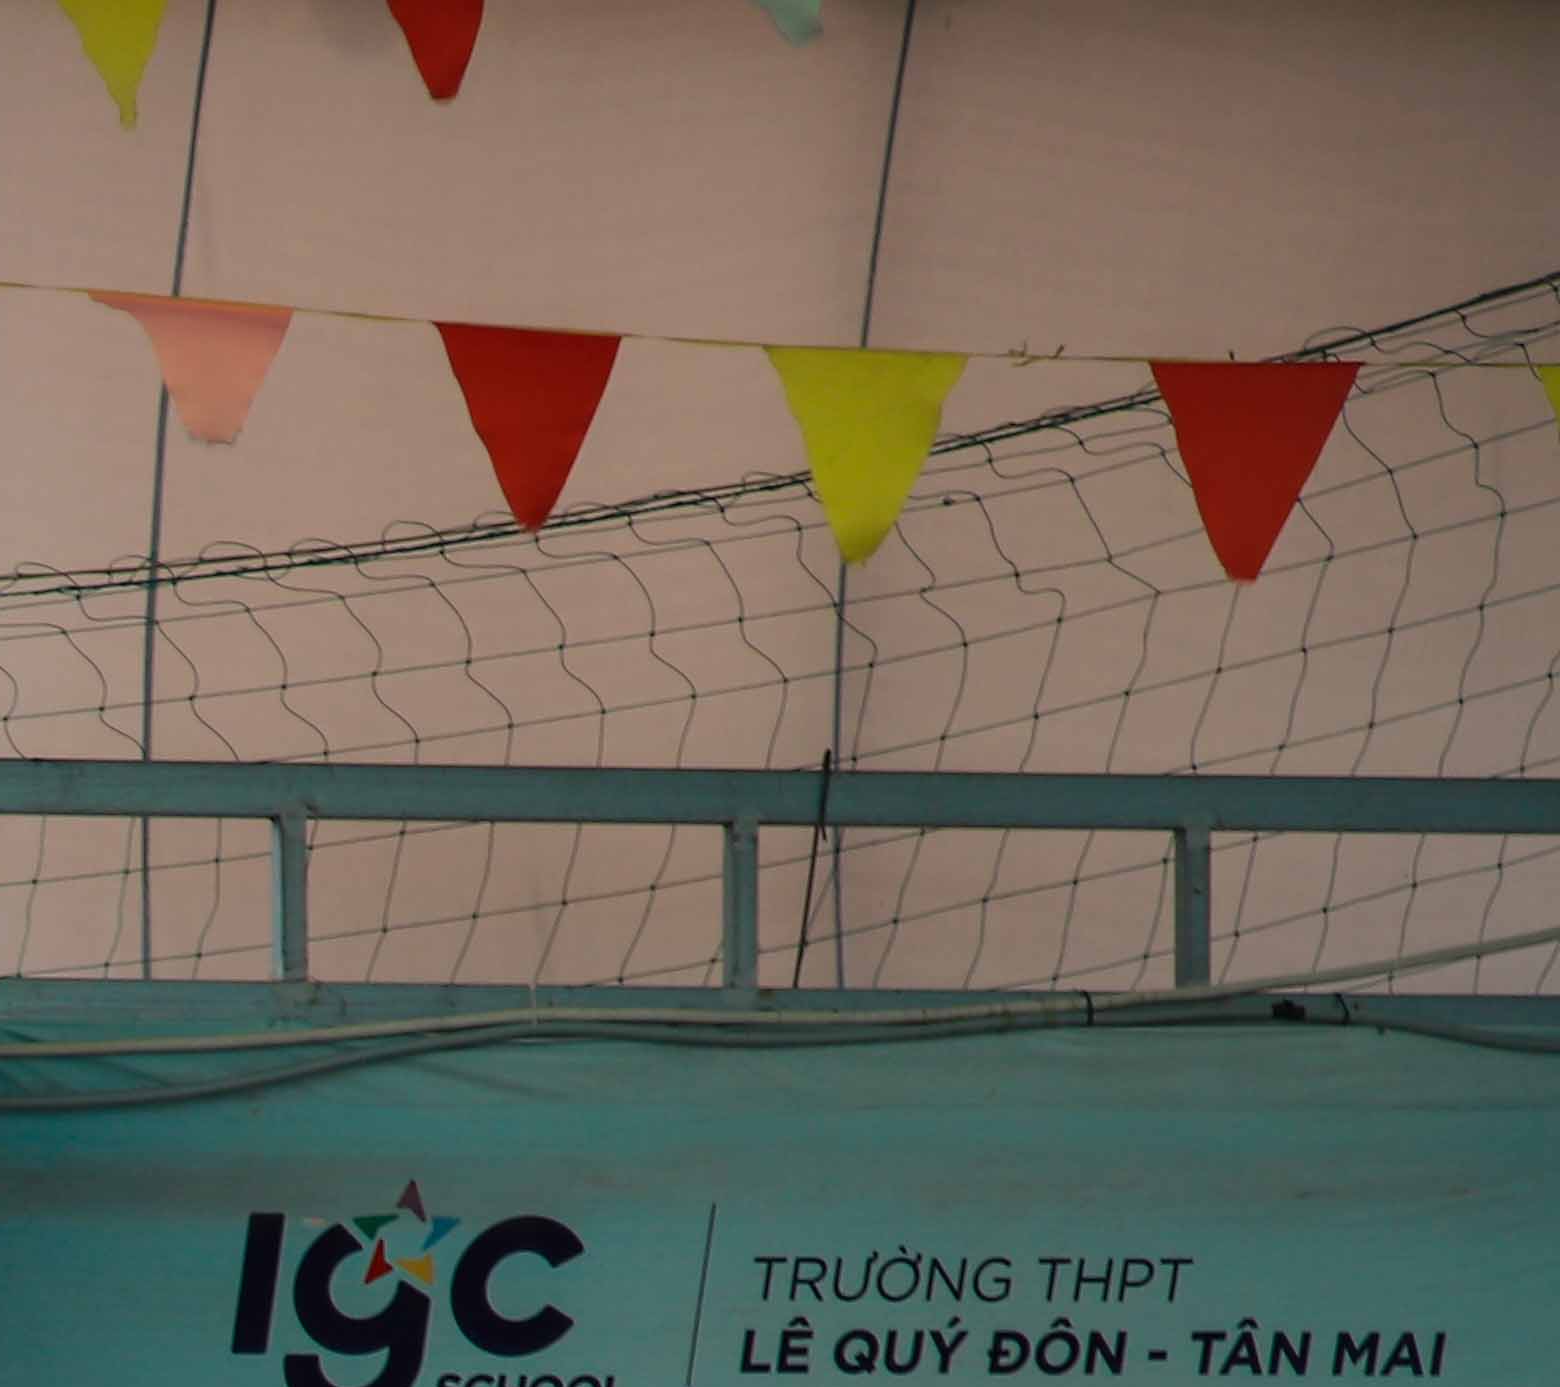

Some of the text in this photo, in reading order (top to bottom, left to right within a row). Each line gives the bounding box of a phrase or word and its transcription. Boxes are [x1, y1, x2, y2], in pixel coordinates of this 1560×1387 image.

[751, 1242, 1196, 1306] TRƯỜNG THPT
[736, 1314, 815, 1377] LÊ
[830, 1314, 971, 1378] QUÝ
[984, 1315, 1129, 1378] ĐÔN
[1188, 1315, 1314, 1379] TÂN
[1328, 1329, 1448, 1380] MAI
